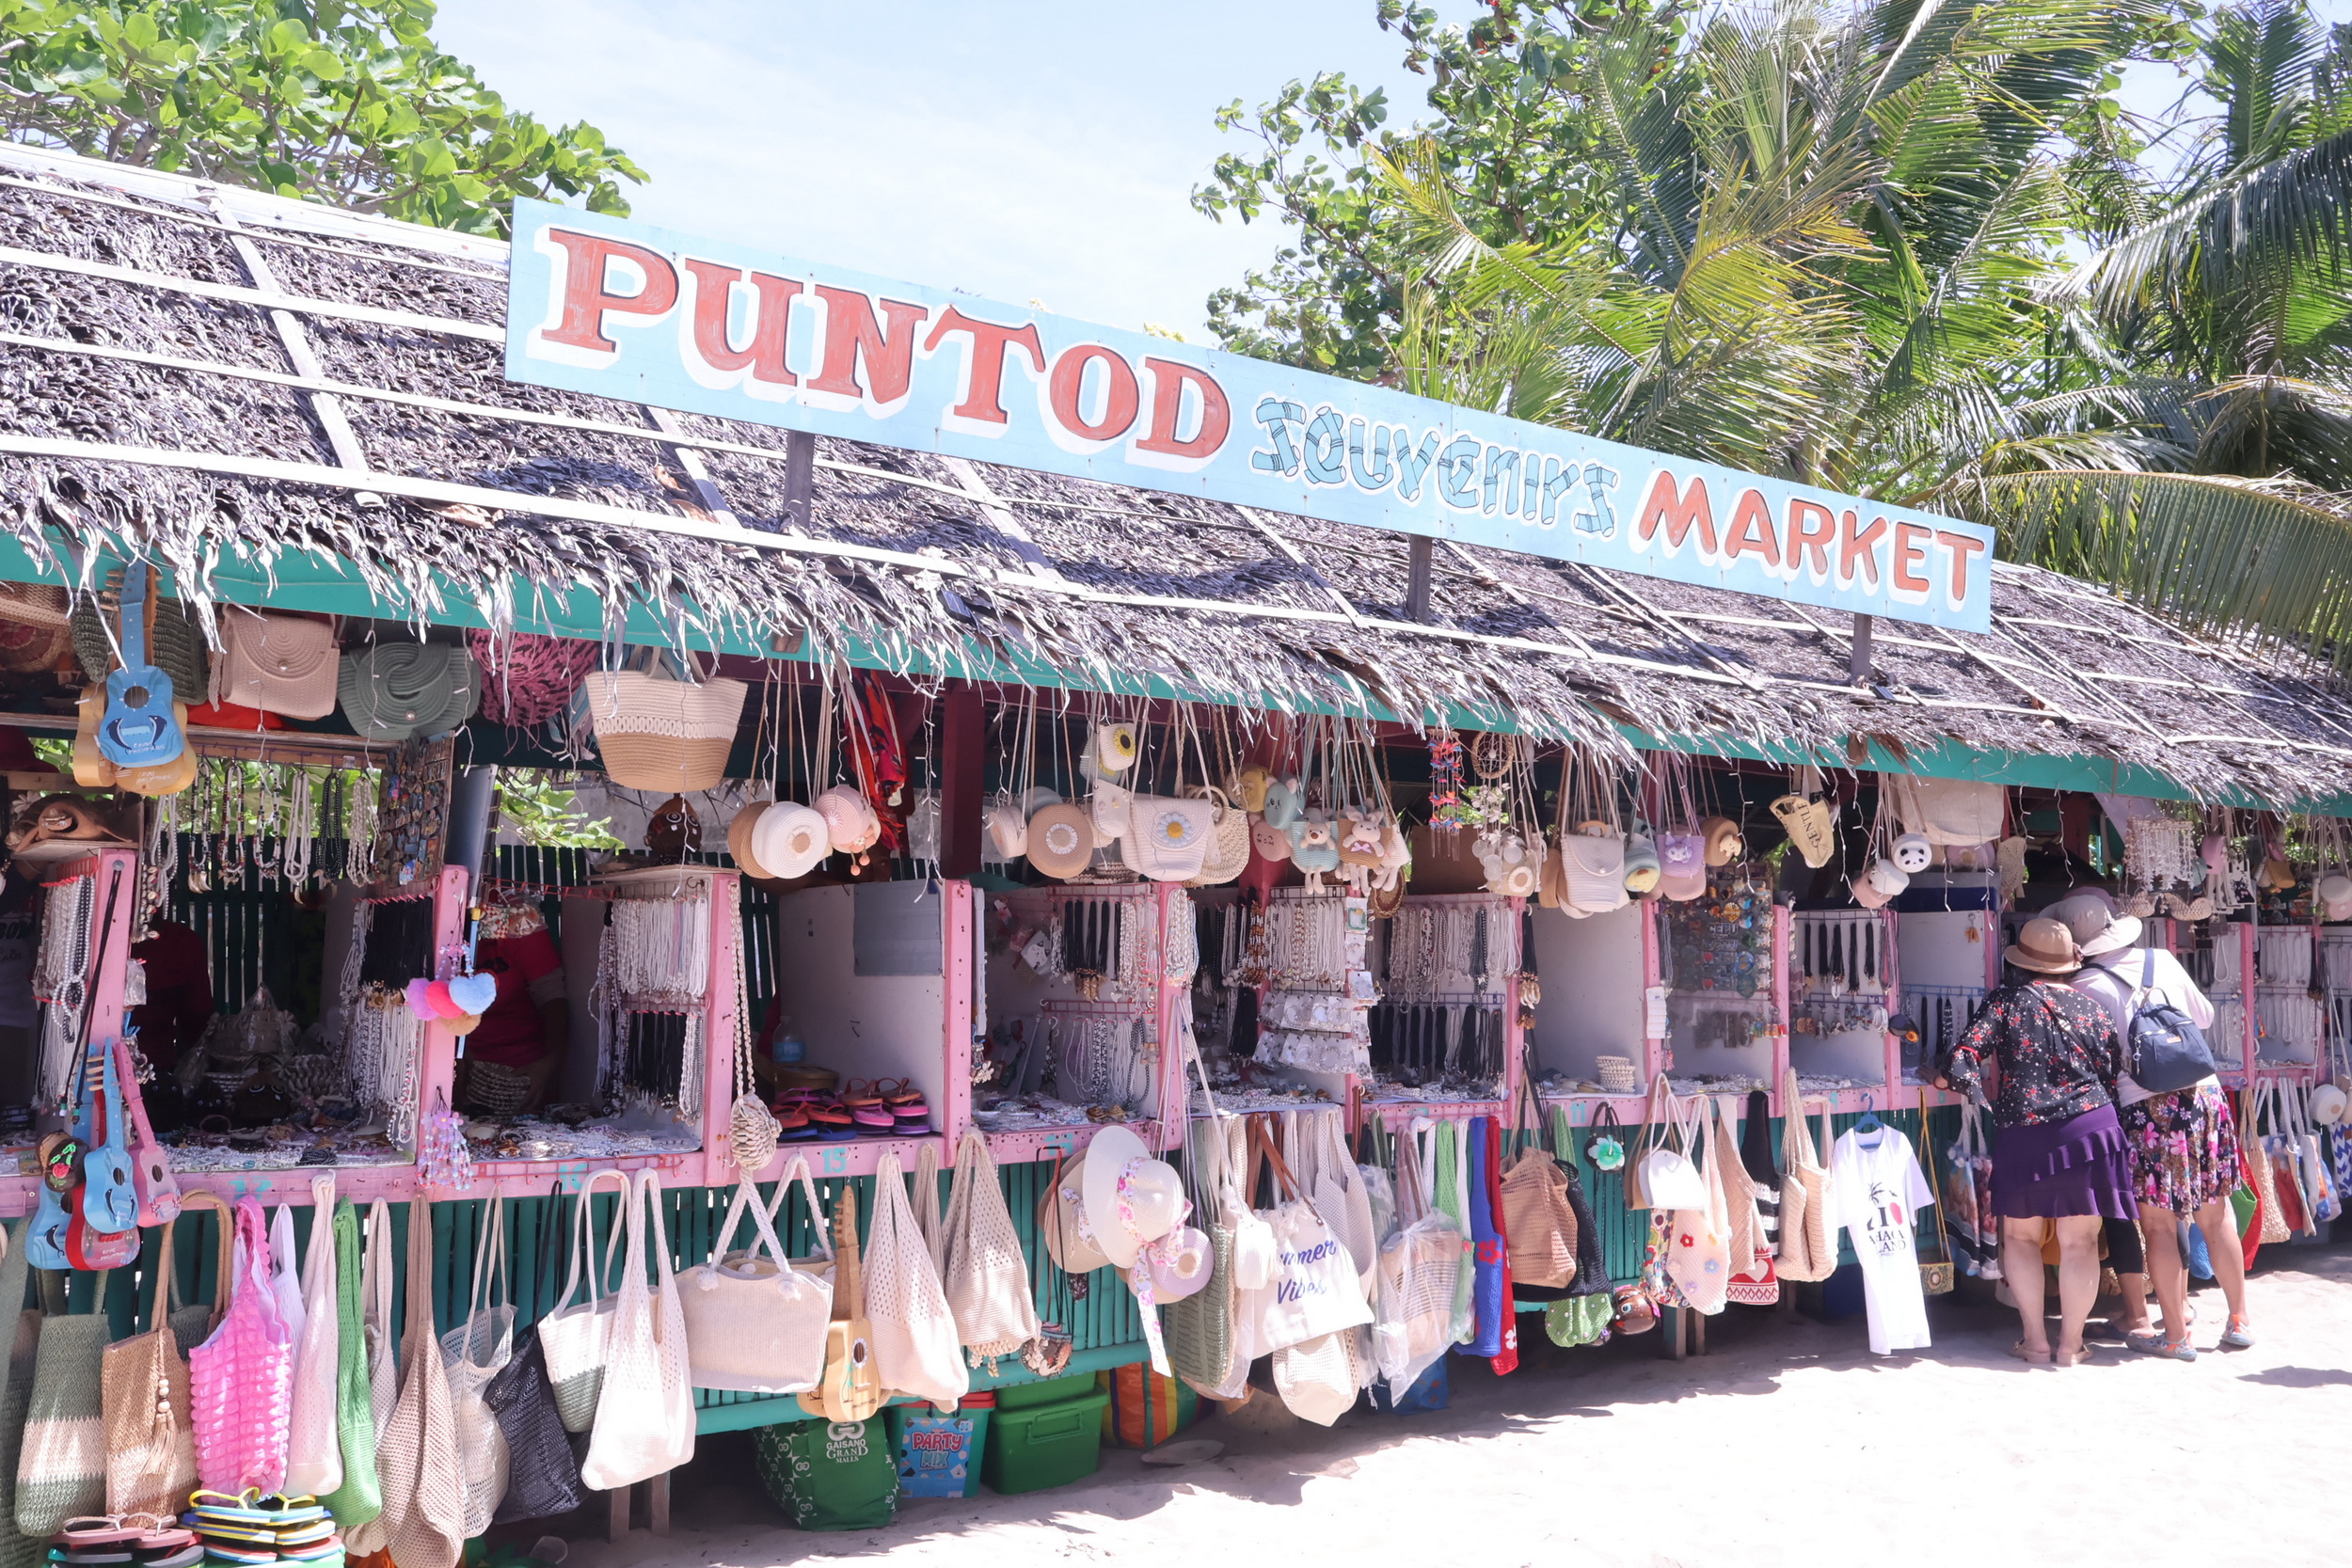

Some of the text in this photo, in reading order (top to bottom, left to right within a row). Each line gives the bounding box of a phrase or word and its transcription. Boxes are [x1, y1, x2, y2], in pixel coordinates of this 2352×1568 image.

[538, 226, 1232, 461] PUNTOD
[1637, 468, 1985, 603] MARKET
[1569, 1101, 1587, 1124] 11
[821, 1147, 847, 1174] 15
[1277, 1275, 1327, 1306] Vibes
[826, 1438, 866, 1450] GAISANO
[912, 1431, 964, 1452] PARTY
[826, 1446, 868, 1460] GRAND
[921, 1450, 949, 1468] MIX
